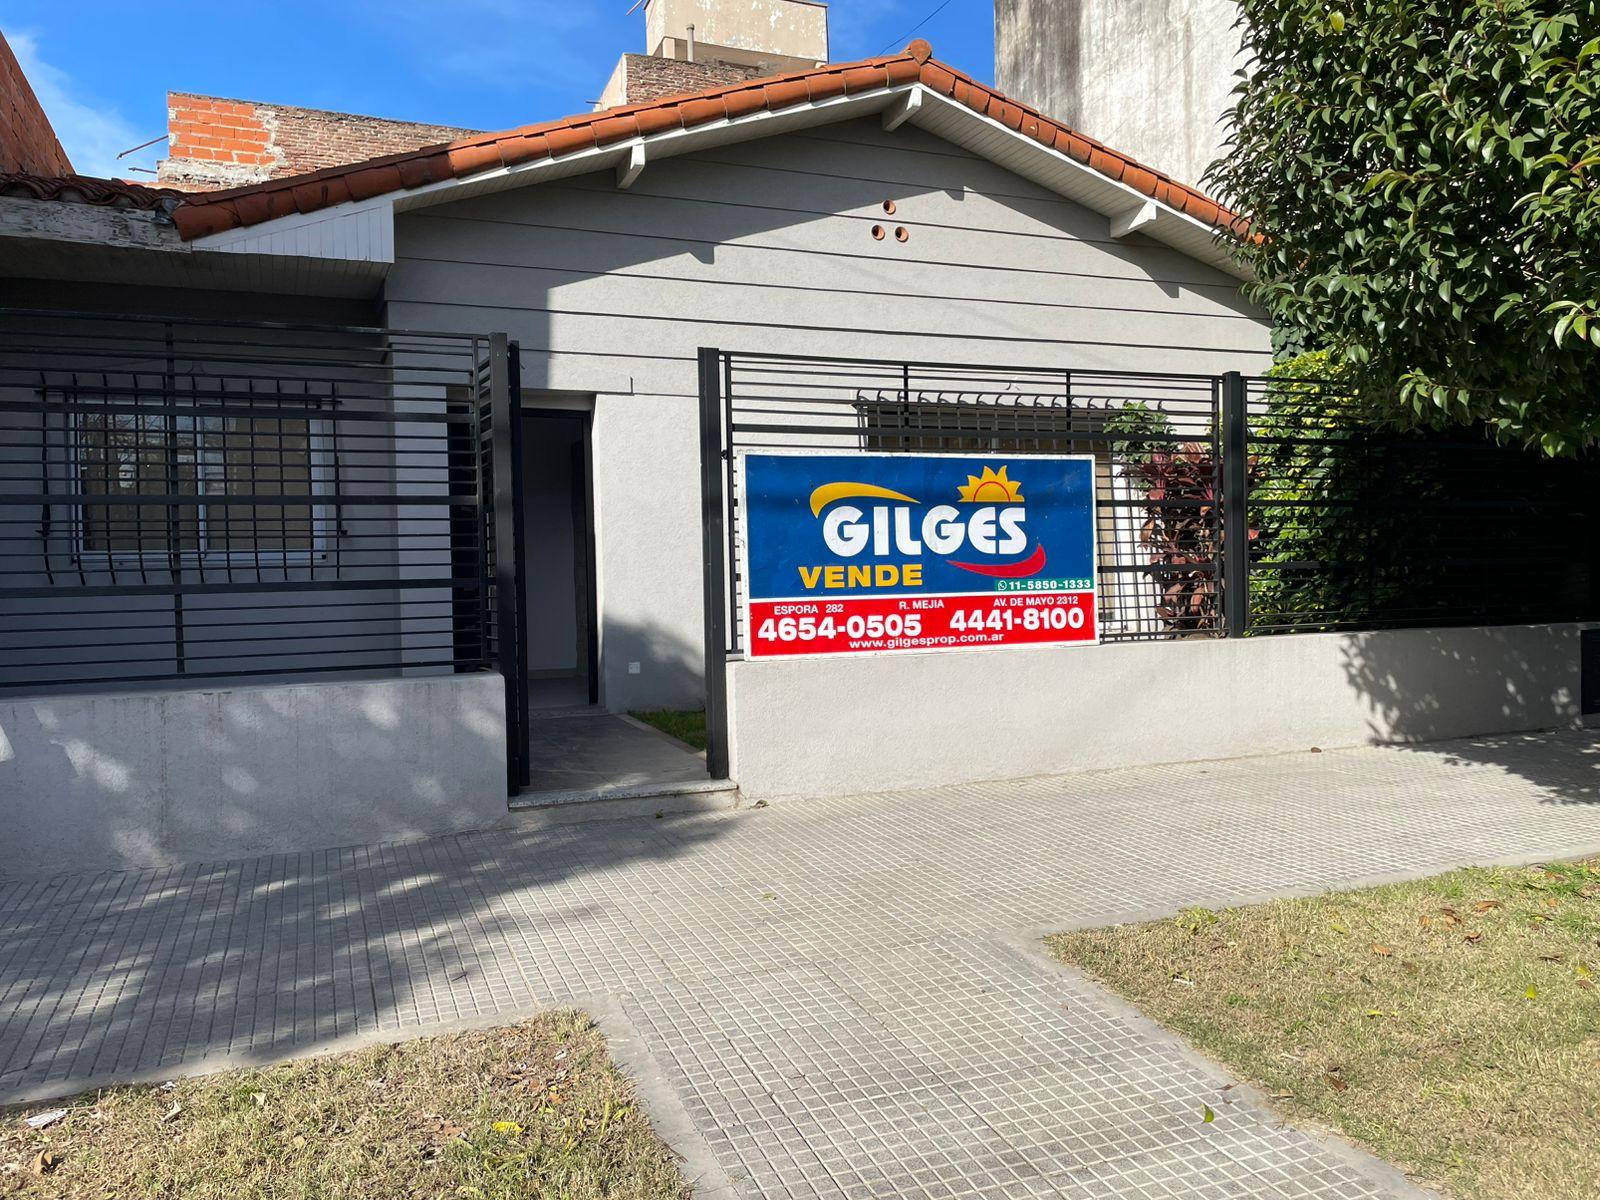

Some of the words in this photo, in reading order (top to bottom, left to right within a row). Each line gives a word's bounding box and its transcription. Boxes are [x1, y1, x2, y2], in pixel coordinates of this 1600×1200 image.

[823, 505, 1027, 557] GILGES
[798, 564, 923, 589] VENDE
[1009, 579, 1091, 590] 11-5850-1333
[774, 604, 819, 615] ESPORA
[825, 603, 844, 614] 282
[899, 601, 909, 610] R.
[912, 600, 944, 610] MEJIA
[993, 598, 1008, 607] AV.
[1010, 597, 1023, 606] DE
[1025, 596, 1055, 606] MAYO
[1057, 595, 1078, 605] 2312
[757, 614, 921, 642] 4654-0505
[950, 607, 1084, 632] 4441-8100
[849, 632, 1004, 649] www.gilgesprop.com.ar
